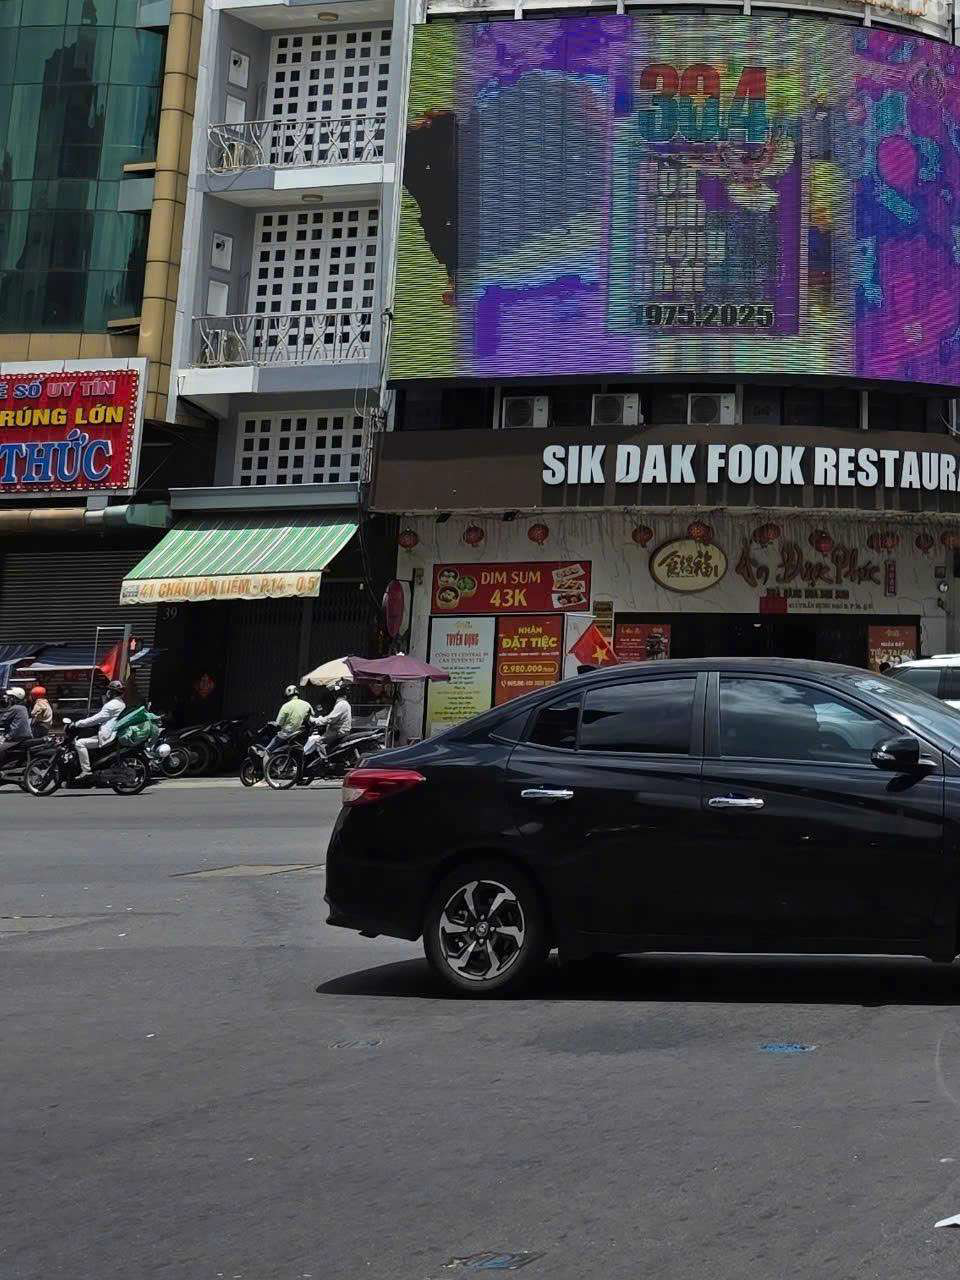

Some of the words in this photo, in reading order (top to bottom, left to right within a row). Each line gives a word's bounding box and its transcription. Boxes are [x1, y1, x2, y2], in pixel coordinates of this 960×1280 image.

[13, 377, 43, 398] SỐ
[47, 381, 75, 397] UY
[80, 378, 116, 396] TÍN
[0, 407, 67, 426] RÚNG
[75, 404, 124, 425] LỚN
[0, 428, 113, 483] THỨC
[542, 444, 606, 485] SIK
[615, 444, 697, 484] DAK
[707, 444, 805, 485] FOOK
[480, 570, 507, 586] DIM
[511, 569, 541, 585] SUM
[489, 588, 528, 608] 43K
[163, 607, 178, 620] 39
[501, 635, 528, 650] ĐẶT
[531, 634, 558, 650] TIỆC
